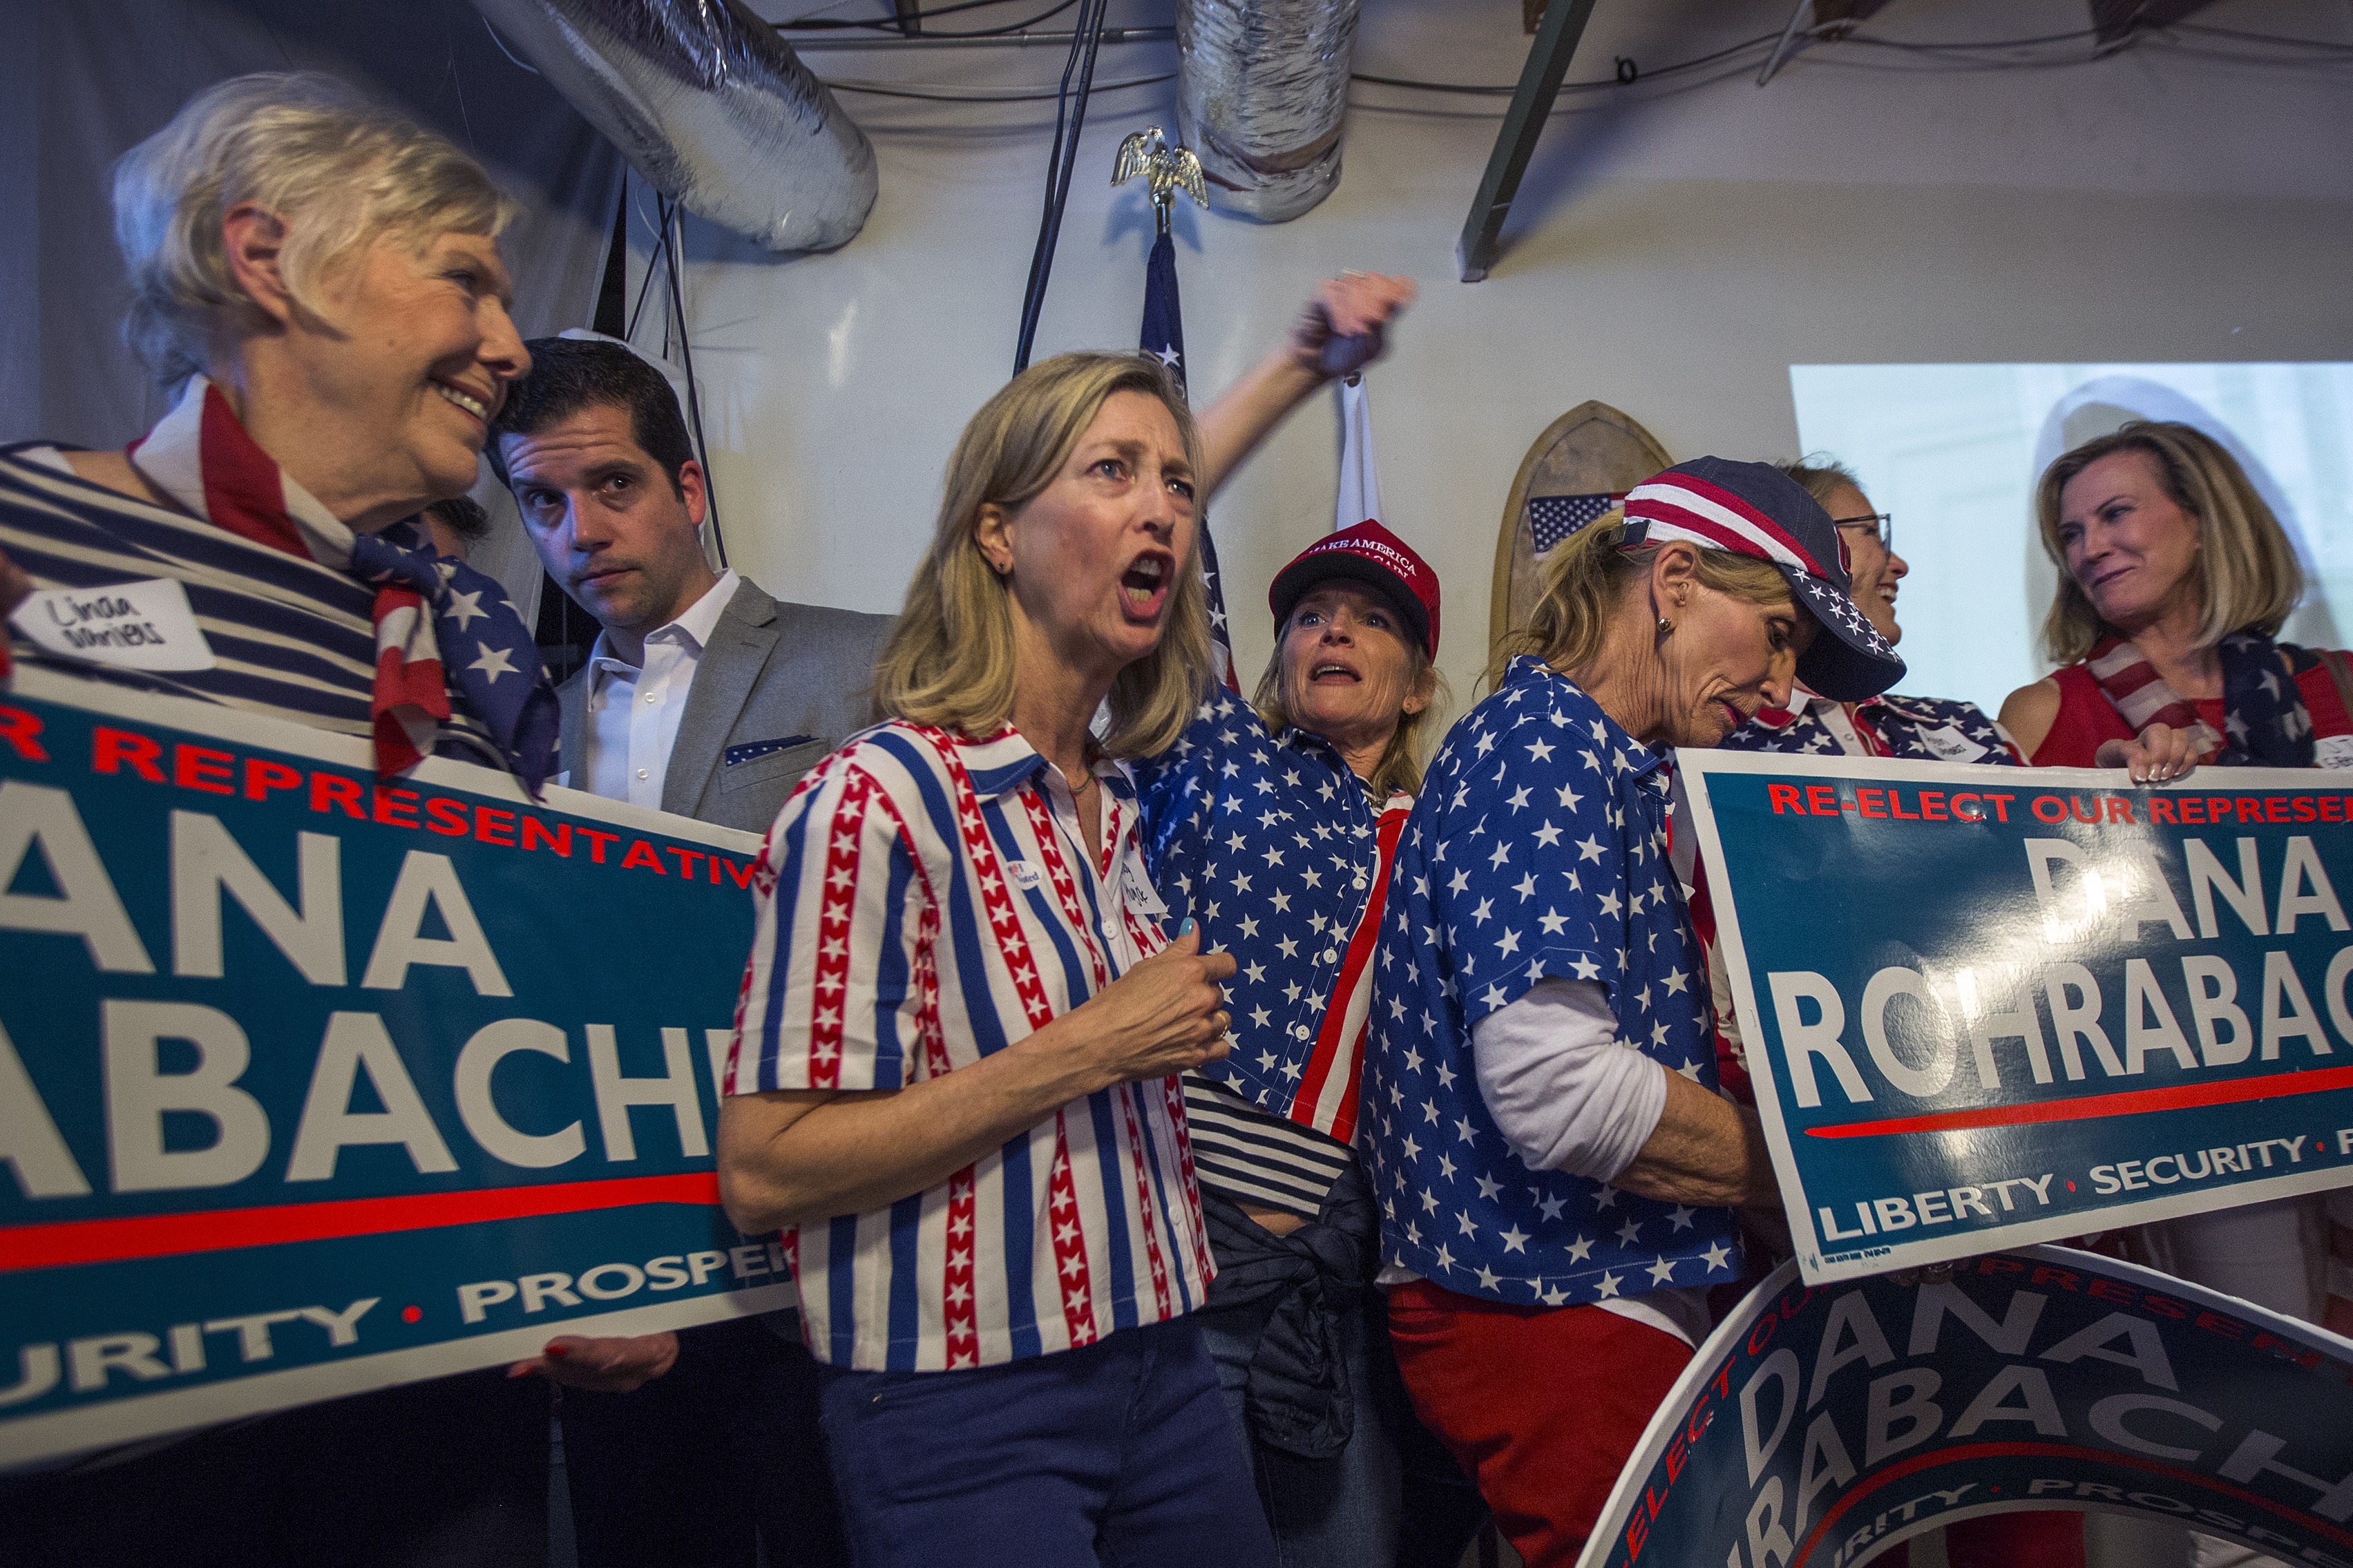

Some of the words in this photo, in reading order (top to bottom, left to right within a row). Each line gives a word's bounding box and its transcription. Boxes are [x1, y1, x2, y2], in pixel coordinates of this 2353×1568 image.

[1350, 538, 1417, 577] AMERICA
[1769, 783, 2015, 823] RE-ELECT
[2031, 794, 2136, 825] OUR
[0, 779, 515, 997] ANA
[2025, 835, 2351, 944] DANA
[1818, 1173, 2055, 1243] LIBERTY
[2089, 1134, 2307, 1196] SECURITY
[1748, 1283, 1829, 1357] OU
[1972, 1257, 2353, 1384] PRESEN
[1739, 1281, 2180, 1490] DANA
